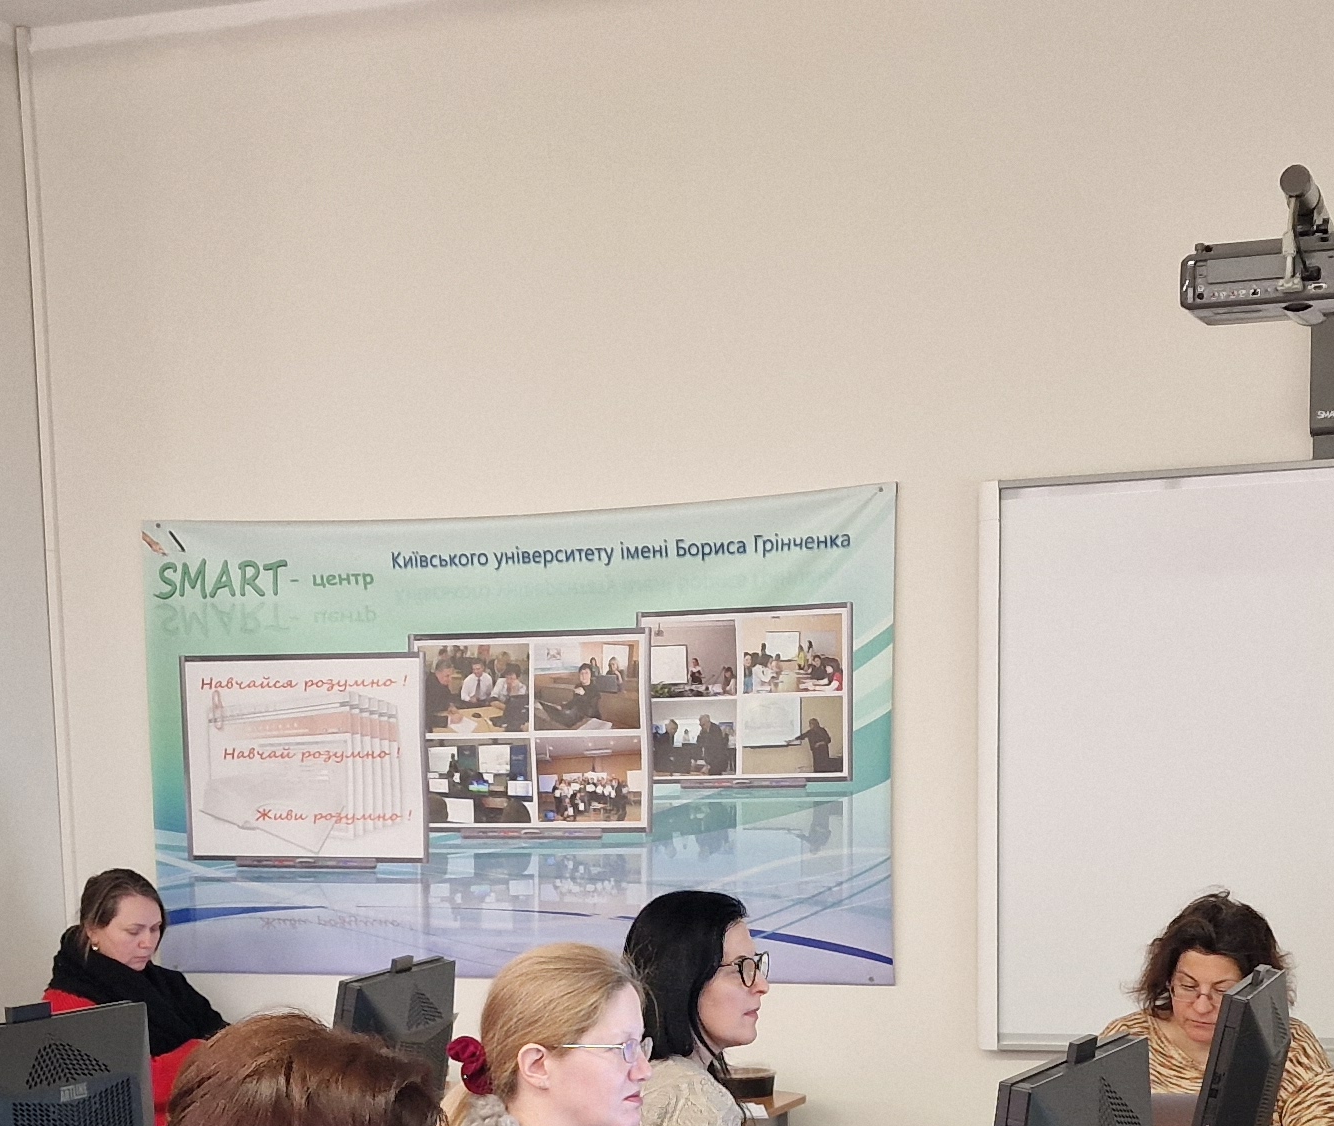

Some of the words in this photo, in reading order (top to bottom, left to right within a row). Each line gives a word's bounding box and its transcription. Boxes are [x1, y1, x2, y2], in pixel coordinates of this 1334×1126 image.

[391, 550, 489, 569] Київського
[493, 545, 614, 571] університету
[620, 539, 669, 560] імені
[675, 538, 747, 561] Бориса
[753, 532, 851, 558] Грінченка
[312, 571, 375, 590] центр
[200, 676, 299, 691] Навчайся
[303, 677, 397, 693] розумно
[223, 747, 297, 761] Навчай
[300, 750, 391, 763] розумно
[255, 808, 308, 822] Живи
[313, 811, 403, 825] розумно
